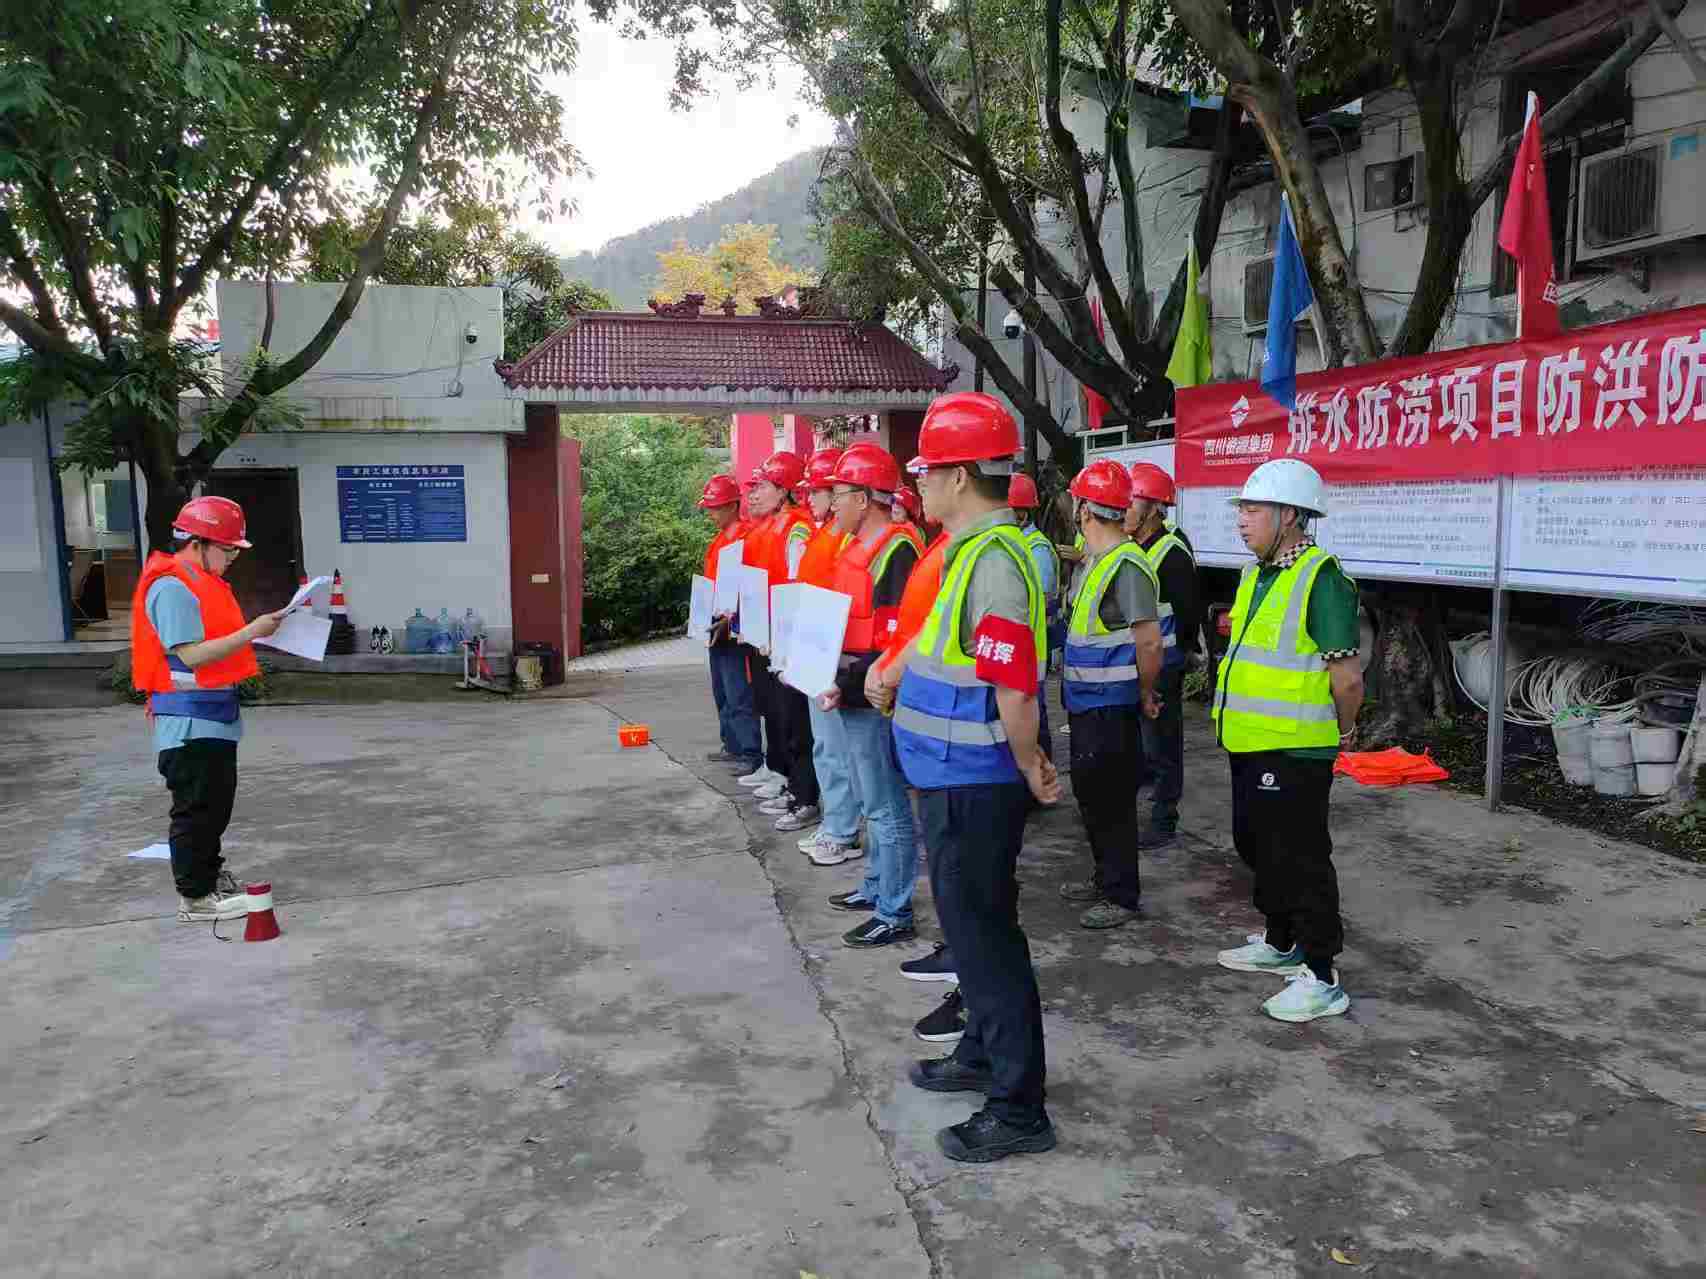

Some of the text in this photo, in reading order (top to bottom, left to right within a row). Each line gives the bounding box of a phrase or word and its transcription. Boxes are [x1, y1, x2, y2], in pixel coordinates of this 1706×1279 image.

[1286, 328, 1706, 453] 排水防涝项目防洪防
[975, 633, 1016, 665] 指挥
